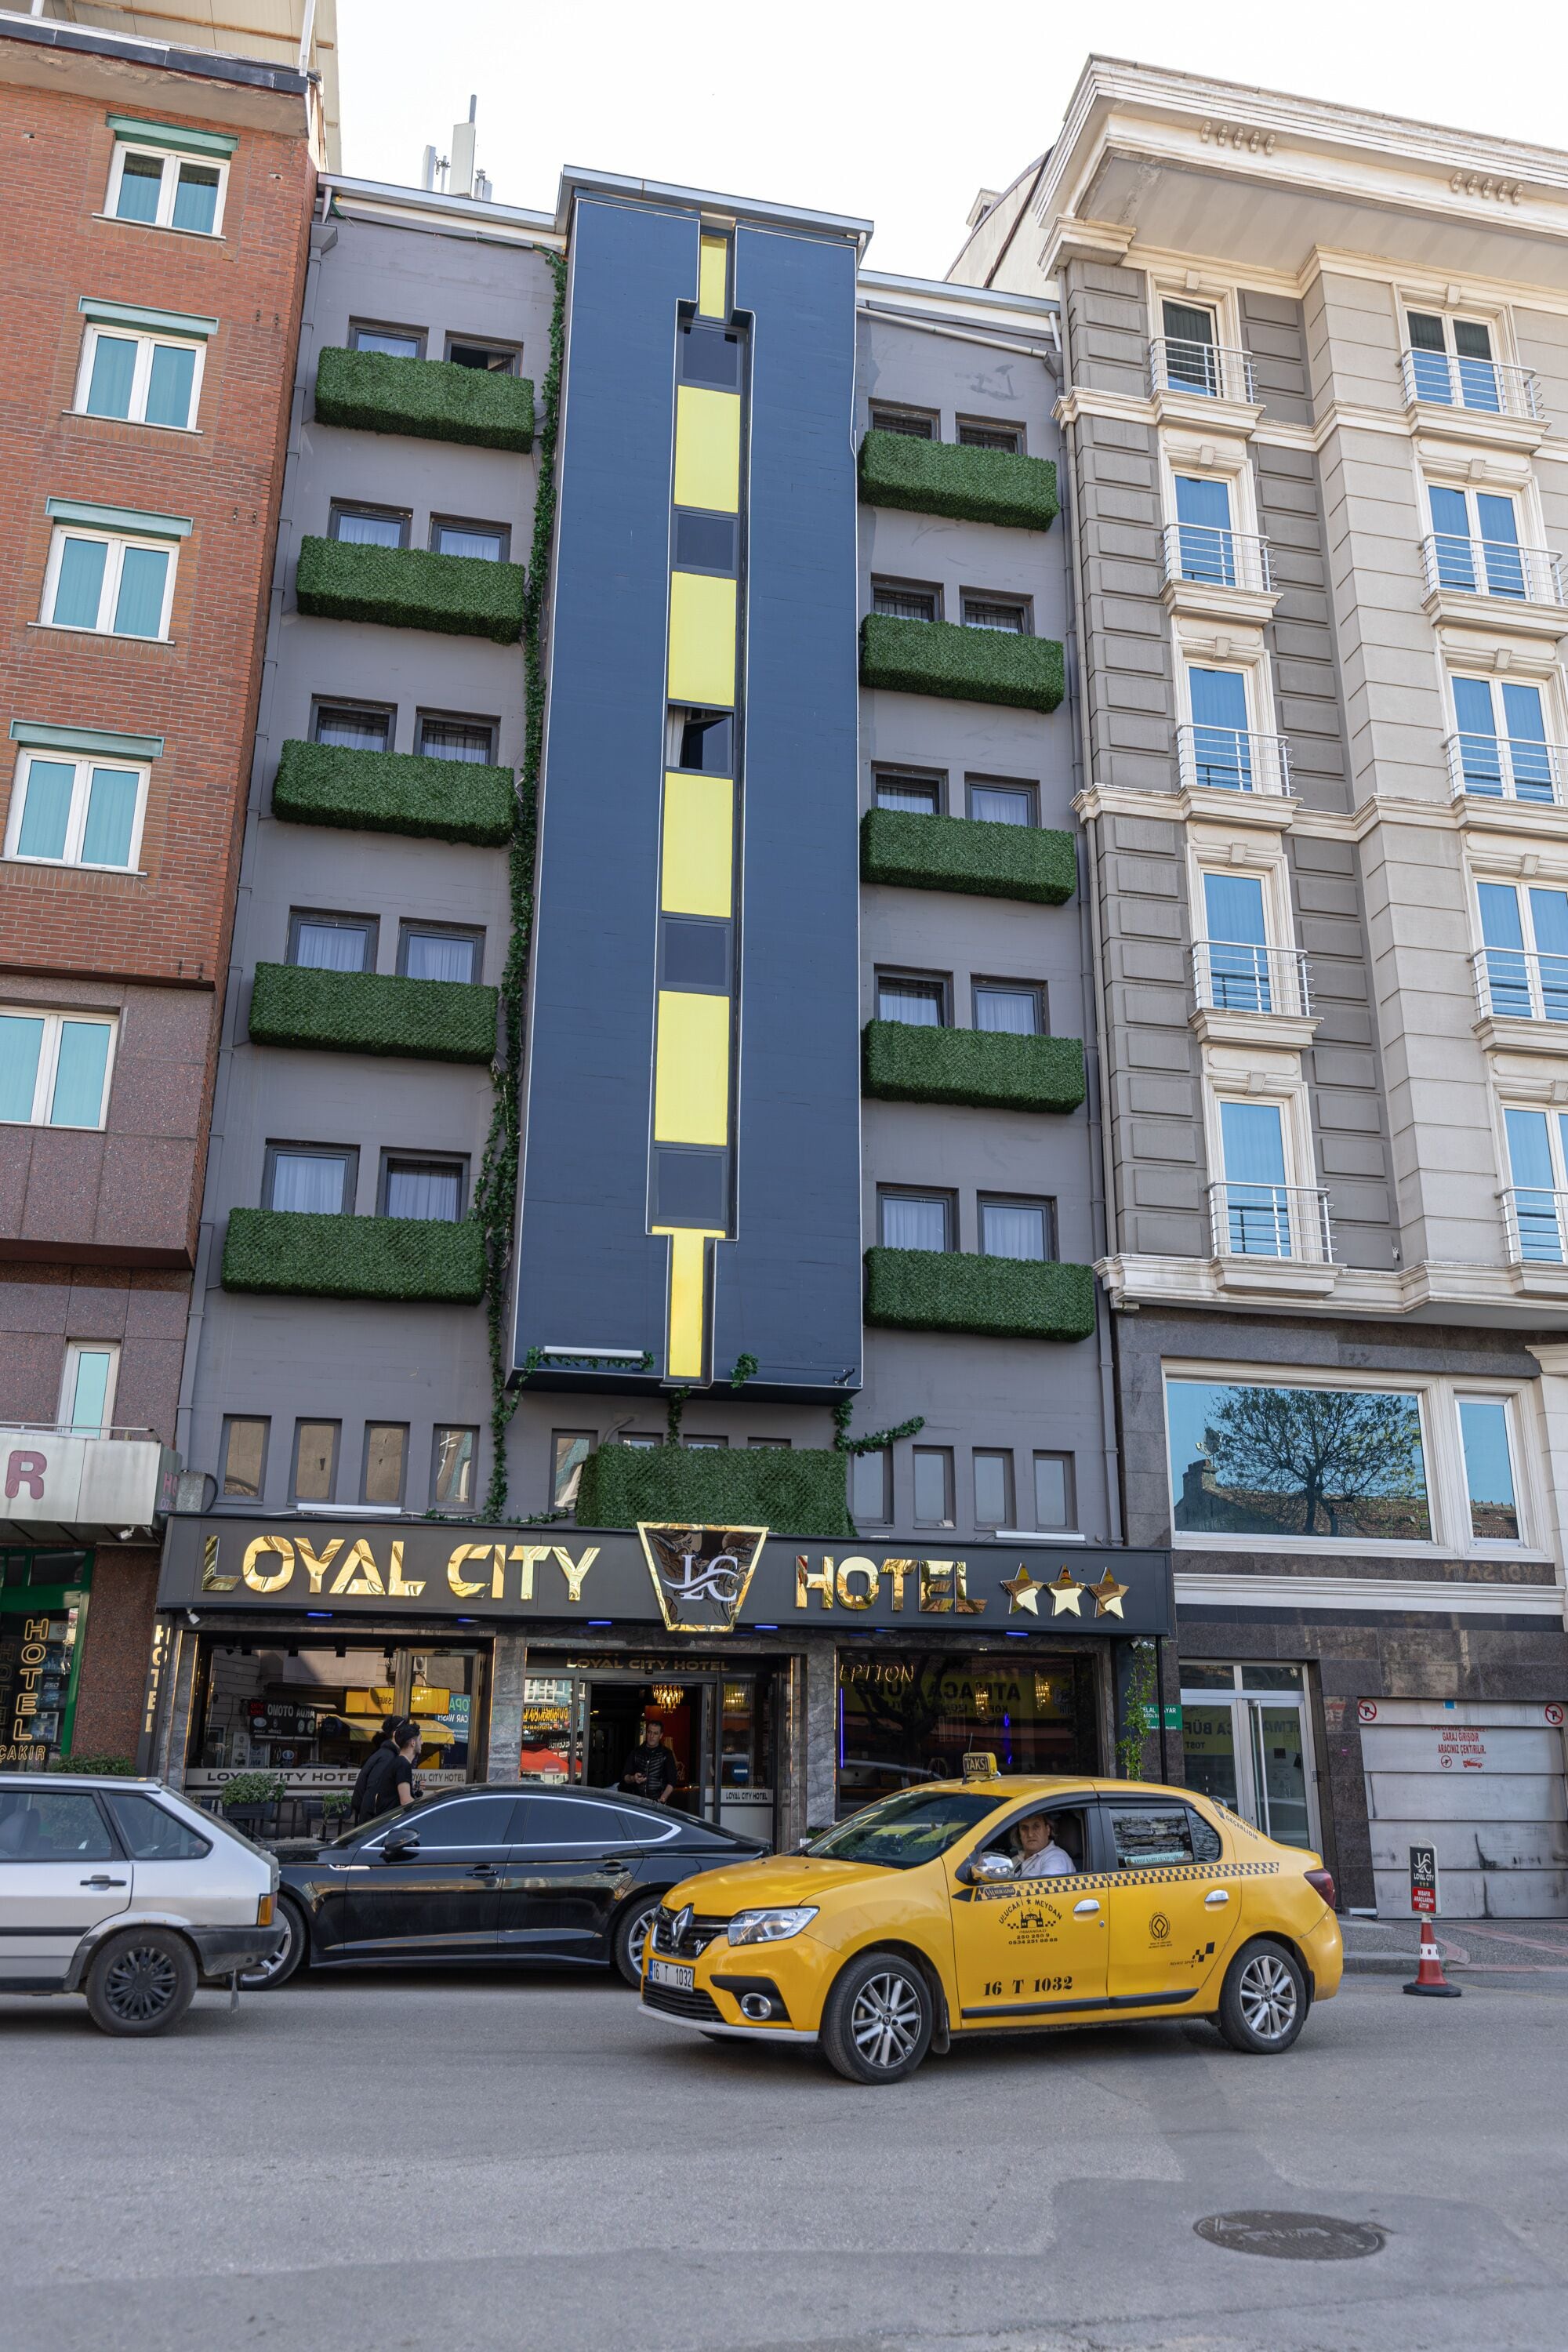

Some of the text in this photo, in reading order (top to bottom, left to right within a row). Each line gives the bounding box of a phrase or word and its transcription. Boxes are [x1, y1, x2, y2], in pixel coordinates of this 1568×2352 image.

[201, 1535, 601, 1602] LOYAL CITY
[795, 1555, 988, 1613] HOTEL
[565, 1657, 730, 1671] LOYAL CITY HOTEL
[13, 1618, 49, 1740] HOTEL
[1443, 1732, 1457, 1742] GARAJ
[0, 1744, 45, 1763] ÇAKIR
[1438, 1744, 1460, 1754] ARACINIZ
[964, 1757, 988, 1770] TAKSİ
[207, 1772, 250, 1781] LOY
[311, 1773, 360, 1782] HOTE
[412, 1773, 465, 1782] OYAL CITY HOTEL
[726, 1791, 768, 1801] LOYAL CITY HOTEL
[1035, 1898, 1062, 1920] MEYDAN
[653, 1961, 691, 1988] 16 T 1032
[983, 1976, 1073, 1996] 16 T 1032
